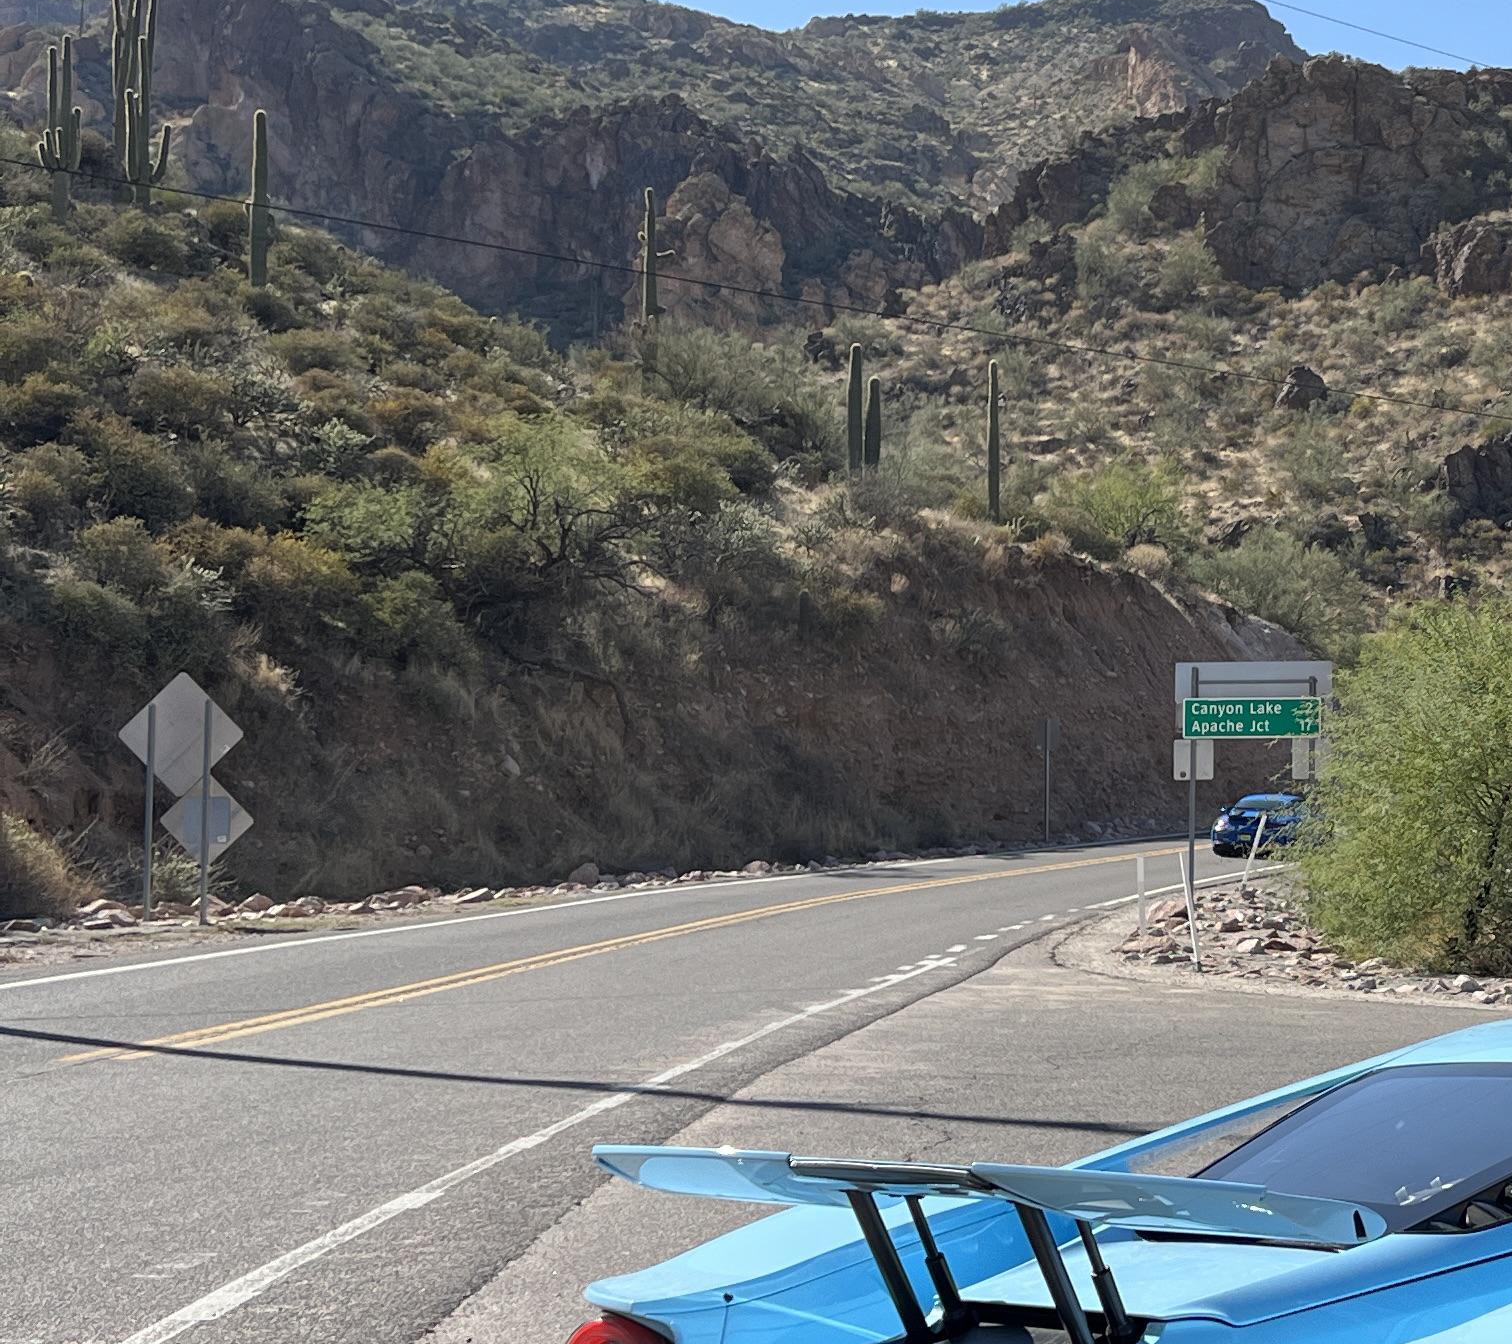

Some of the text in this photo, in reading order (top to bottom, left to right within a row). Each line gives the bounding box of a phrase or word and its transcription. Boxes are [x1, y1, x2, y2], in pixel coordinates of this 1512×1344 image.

[1191, 702, 1243, 718] Canyon
[1250, 702, 1282, 714] Lake
[1191, 719, 1244, 735] Apache
[1250, 719, 1270, 732] Jct
